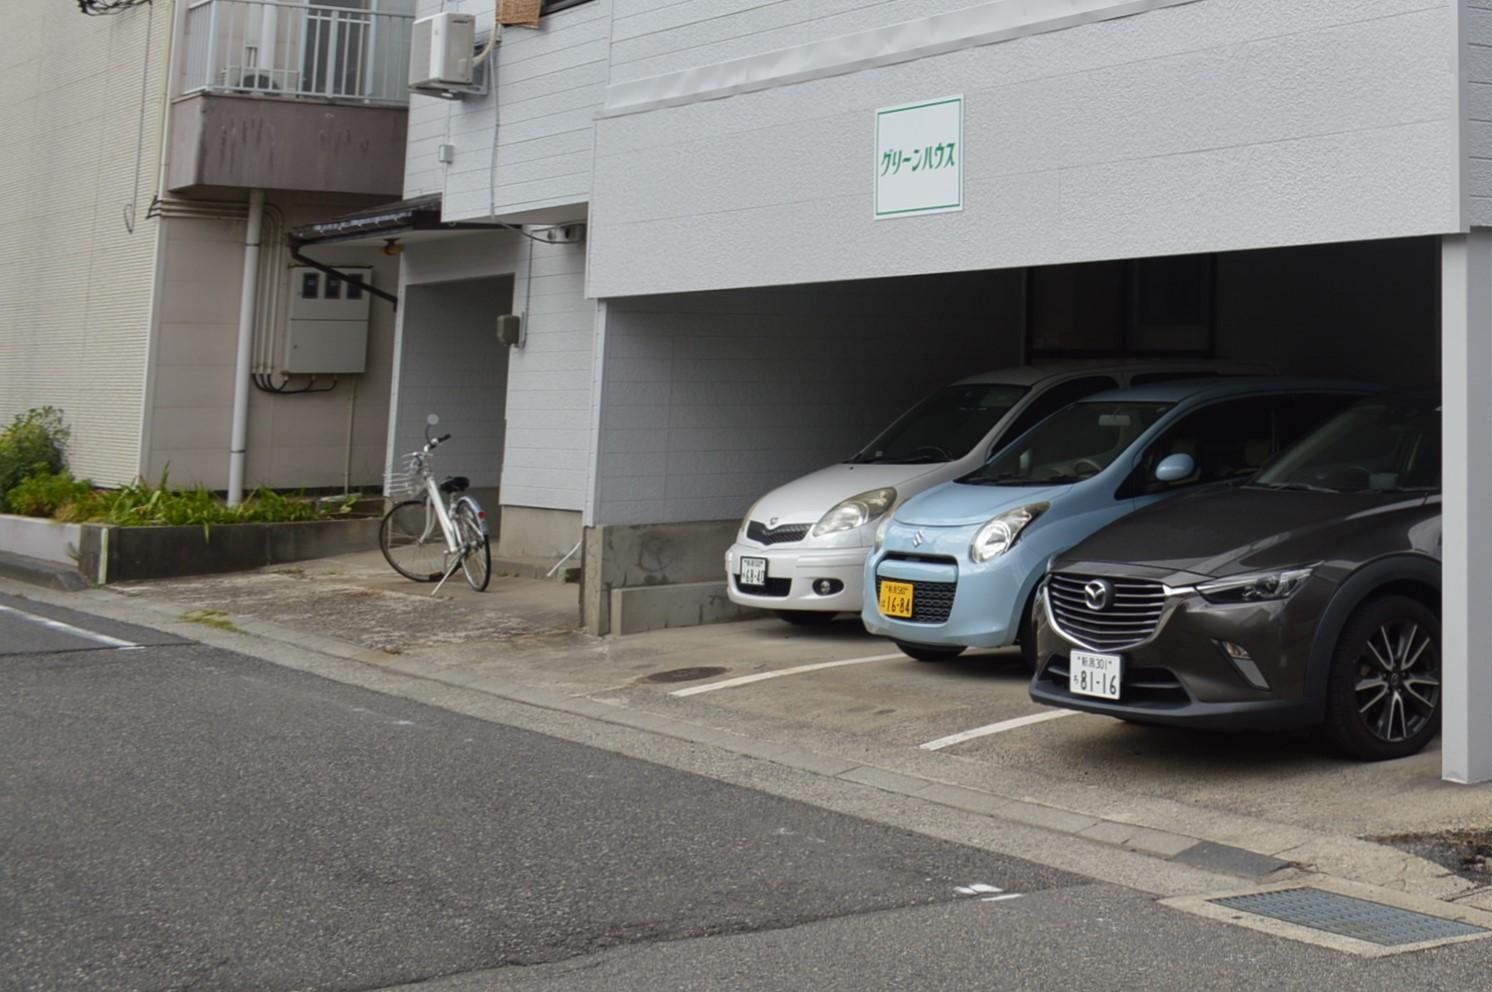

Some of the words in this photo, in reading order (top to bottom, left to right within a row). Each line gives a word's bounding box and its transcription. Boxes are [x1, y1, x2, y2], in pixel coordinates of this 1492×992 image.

[881, 142, 956, 176] グリーンハウス
[1081, 669, 1117, 695] 81-16
